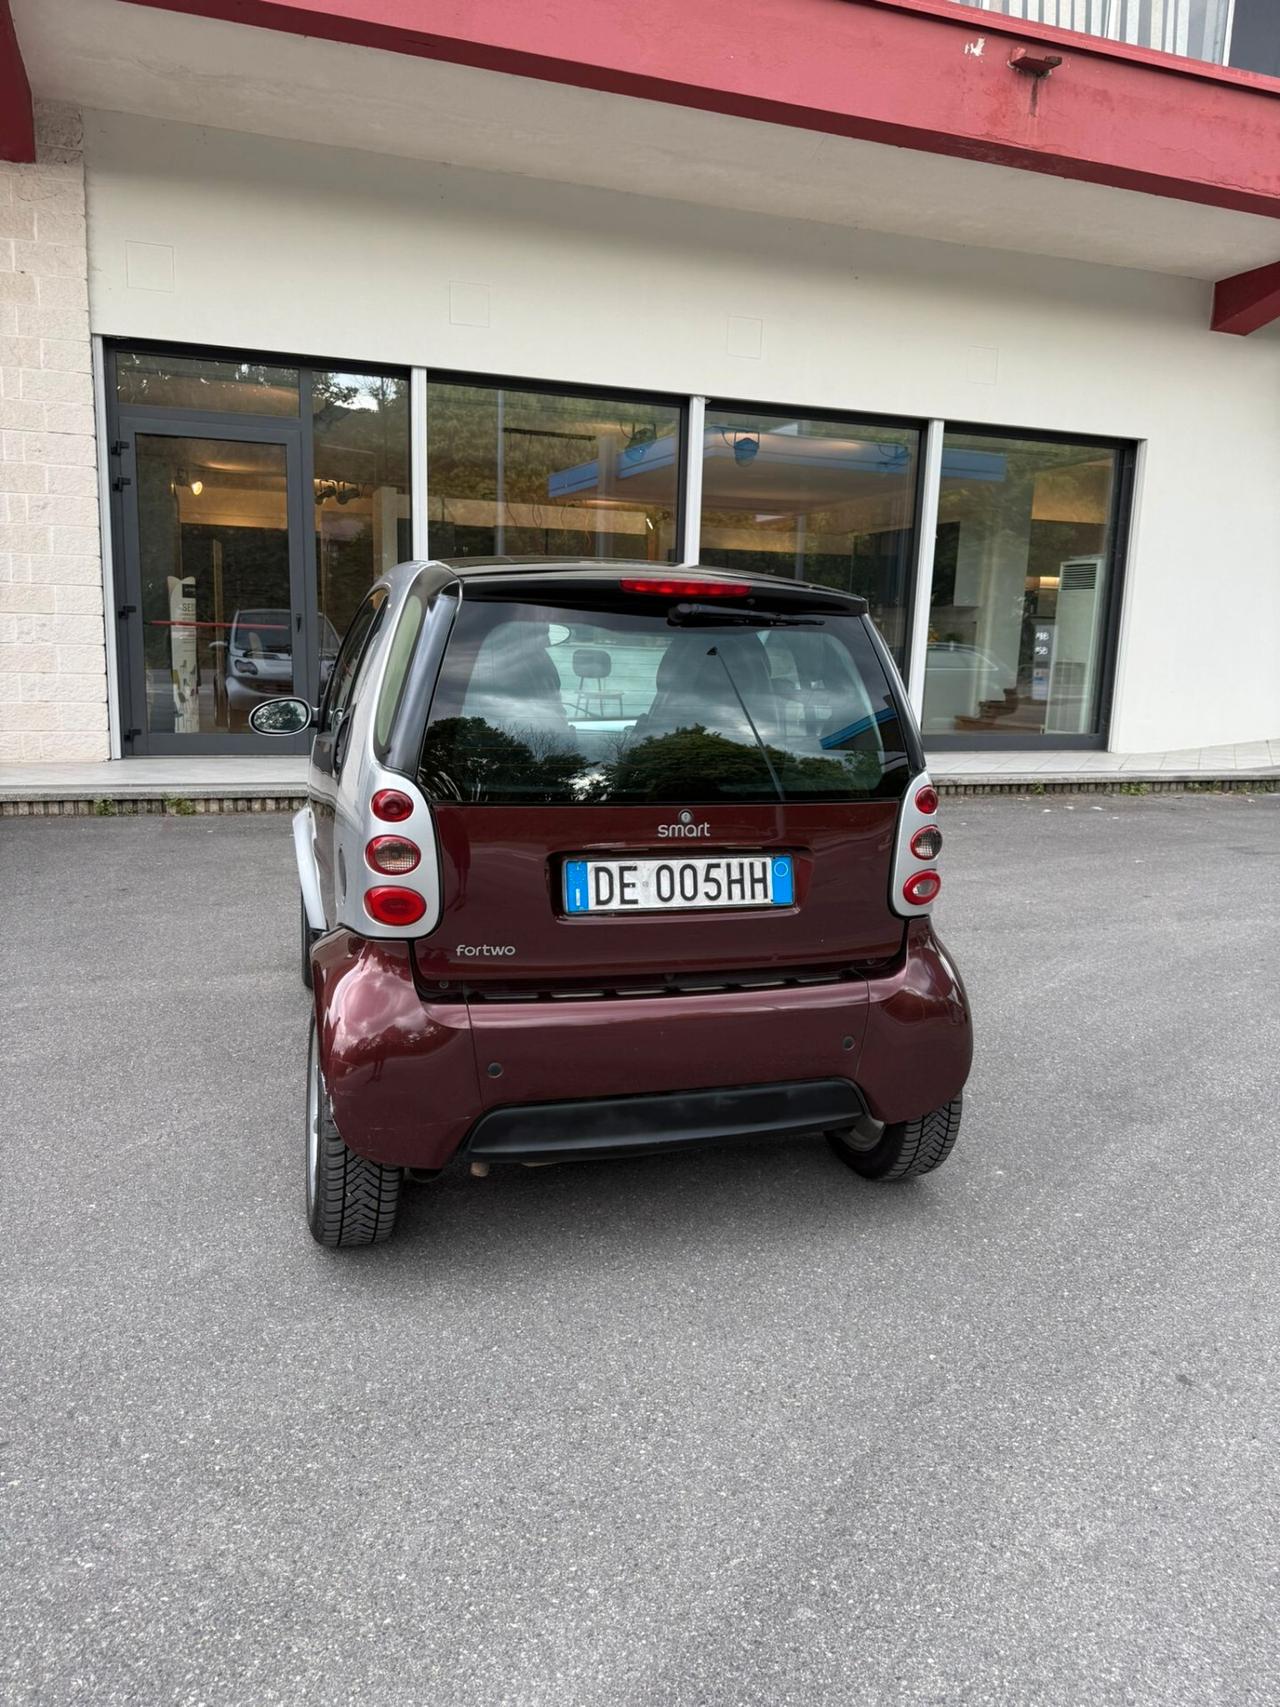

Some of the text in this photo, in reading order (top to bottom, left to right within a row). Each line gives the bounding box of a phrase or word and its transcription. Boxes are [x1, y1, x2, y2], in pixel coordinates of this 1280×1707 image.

[657, 822, 711, 838] smart
[594, 861, 769, 906] DE 005HH
[456, 944, 516, 956] fortwo
